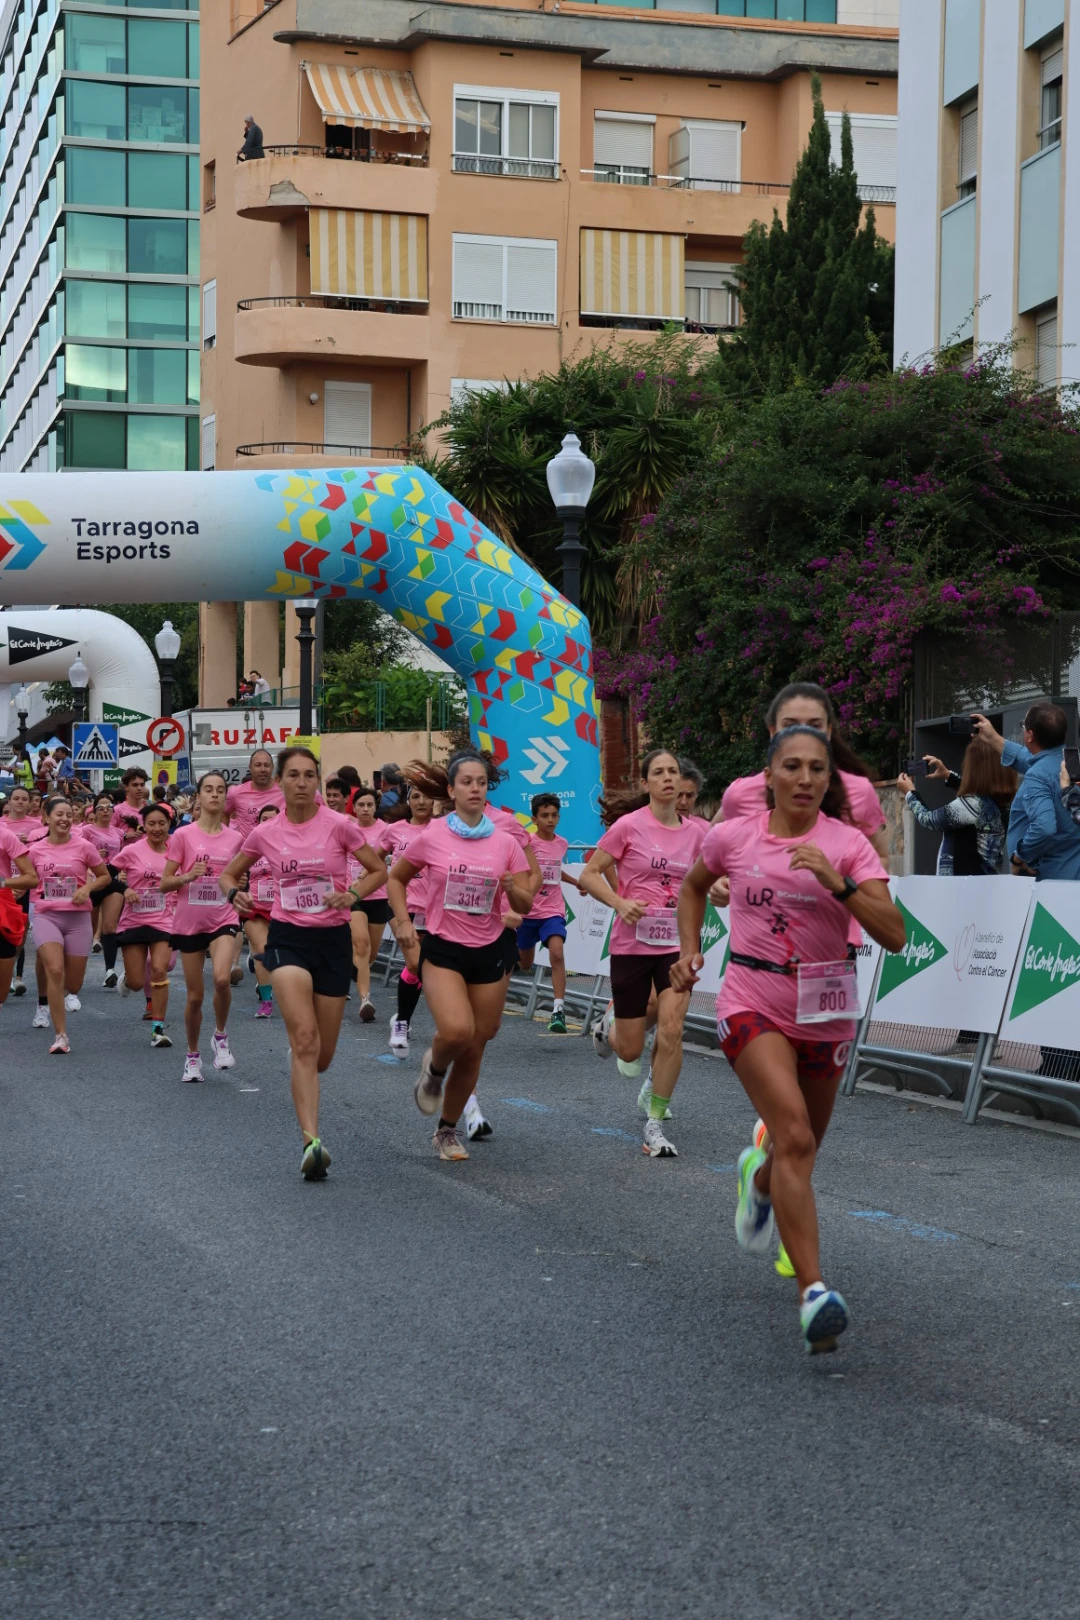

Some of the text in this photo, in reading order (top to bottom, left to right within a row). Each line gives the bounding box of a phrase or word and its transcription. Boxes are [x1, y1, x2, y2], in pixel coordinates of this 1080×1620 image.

[71, 518, 200, 539] Tarragona
[77, 542, 171, 563] Esports
[10, 637, 63, 651] El Corte Inglés
[51, 889, 67, 898] 2107
[296, 893, 319, 908] 1363
[458, 892, 480, 907] 3314
[746, 886, 774, 907] WR
[649, 926, 672, 940] 2326
[906, 930, 935, 967] Inglés
[1033, 946, 1055, 972] Corte
[819, 990, 847, 1011] 800
